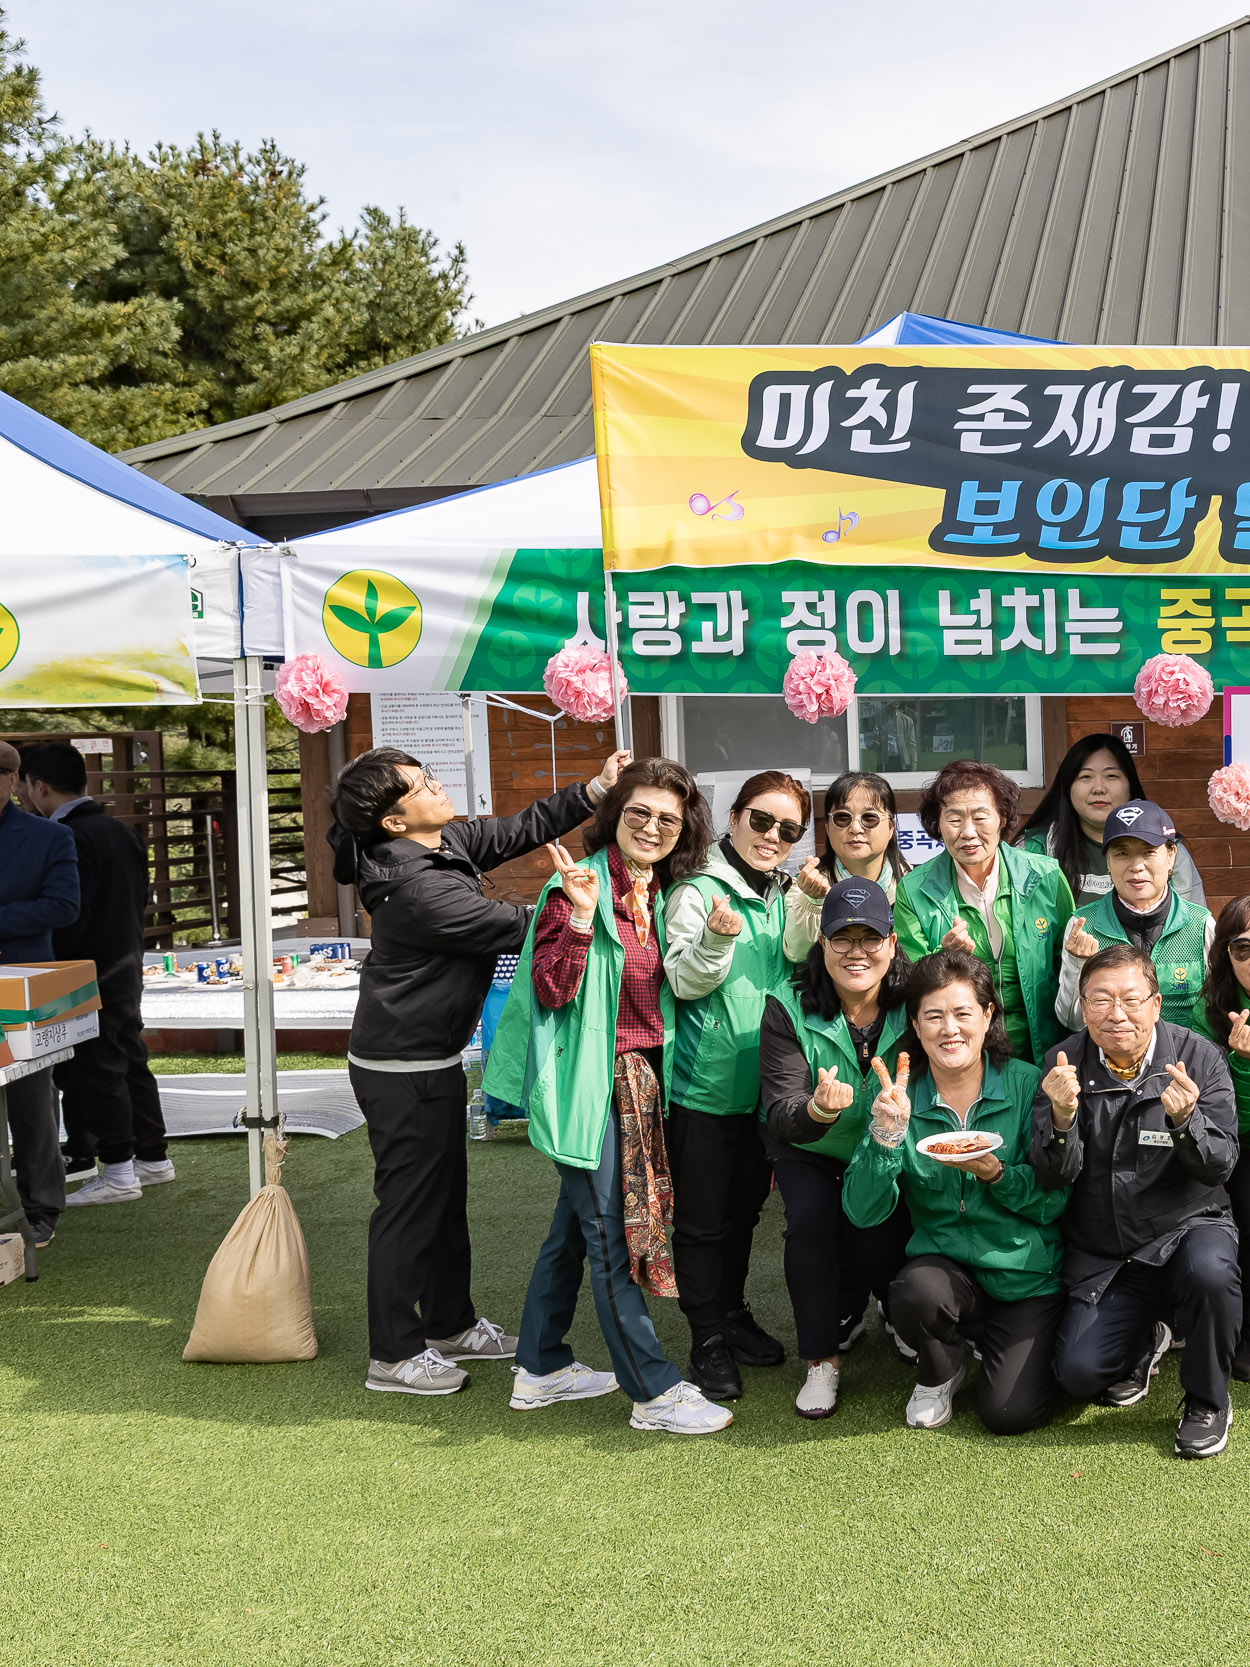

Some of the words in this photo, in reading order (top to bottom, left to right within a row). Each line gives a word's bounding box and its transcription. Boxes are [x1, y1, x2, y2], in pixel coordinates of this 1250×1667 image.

[756, 378, 918, 455] 미친
[953, 379, 1241, 457] 존재감!
[944, 477, 1196, 551] 보인단
[565, 591, 749, 656] 사랑과
[780, 589, 901, 656] 정이
[939, 588, 1123, 655] 넘치는
[35, 1023, 68, 1048] 고랭지상추
[395, 1362, 424, 1384] N
